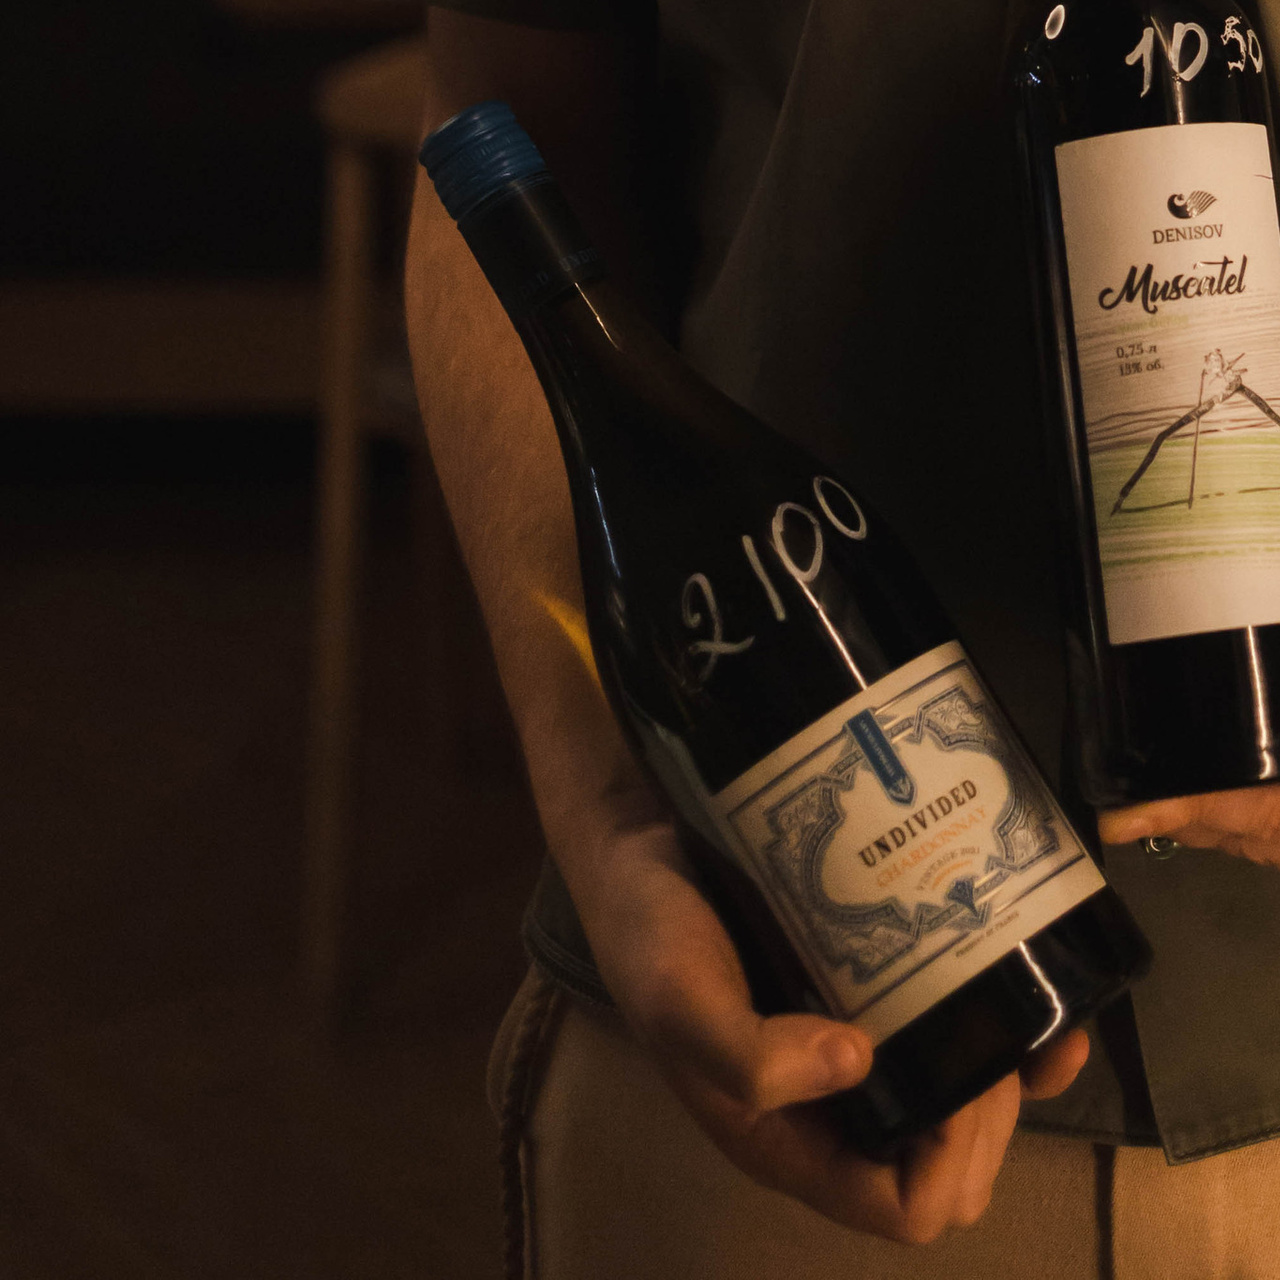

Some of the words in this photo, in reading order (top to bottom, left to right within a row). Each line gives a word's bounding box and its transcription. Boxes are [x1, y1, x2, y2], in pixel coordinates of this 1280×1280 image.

[1152, 224, 1223, 244] DENISOV
[1099, 255, 1247, 315] Muscatel
[1116, 343, 1144, 359] 0,75
[1119, 362, 1142, 376] 13%
[678, 474, 868, 664] 2100
[858, 780, 977, 867] UNDIVIDED
